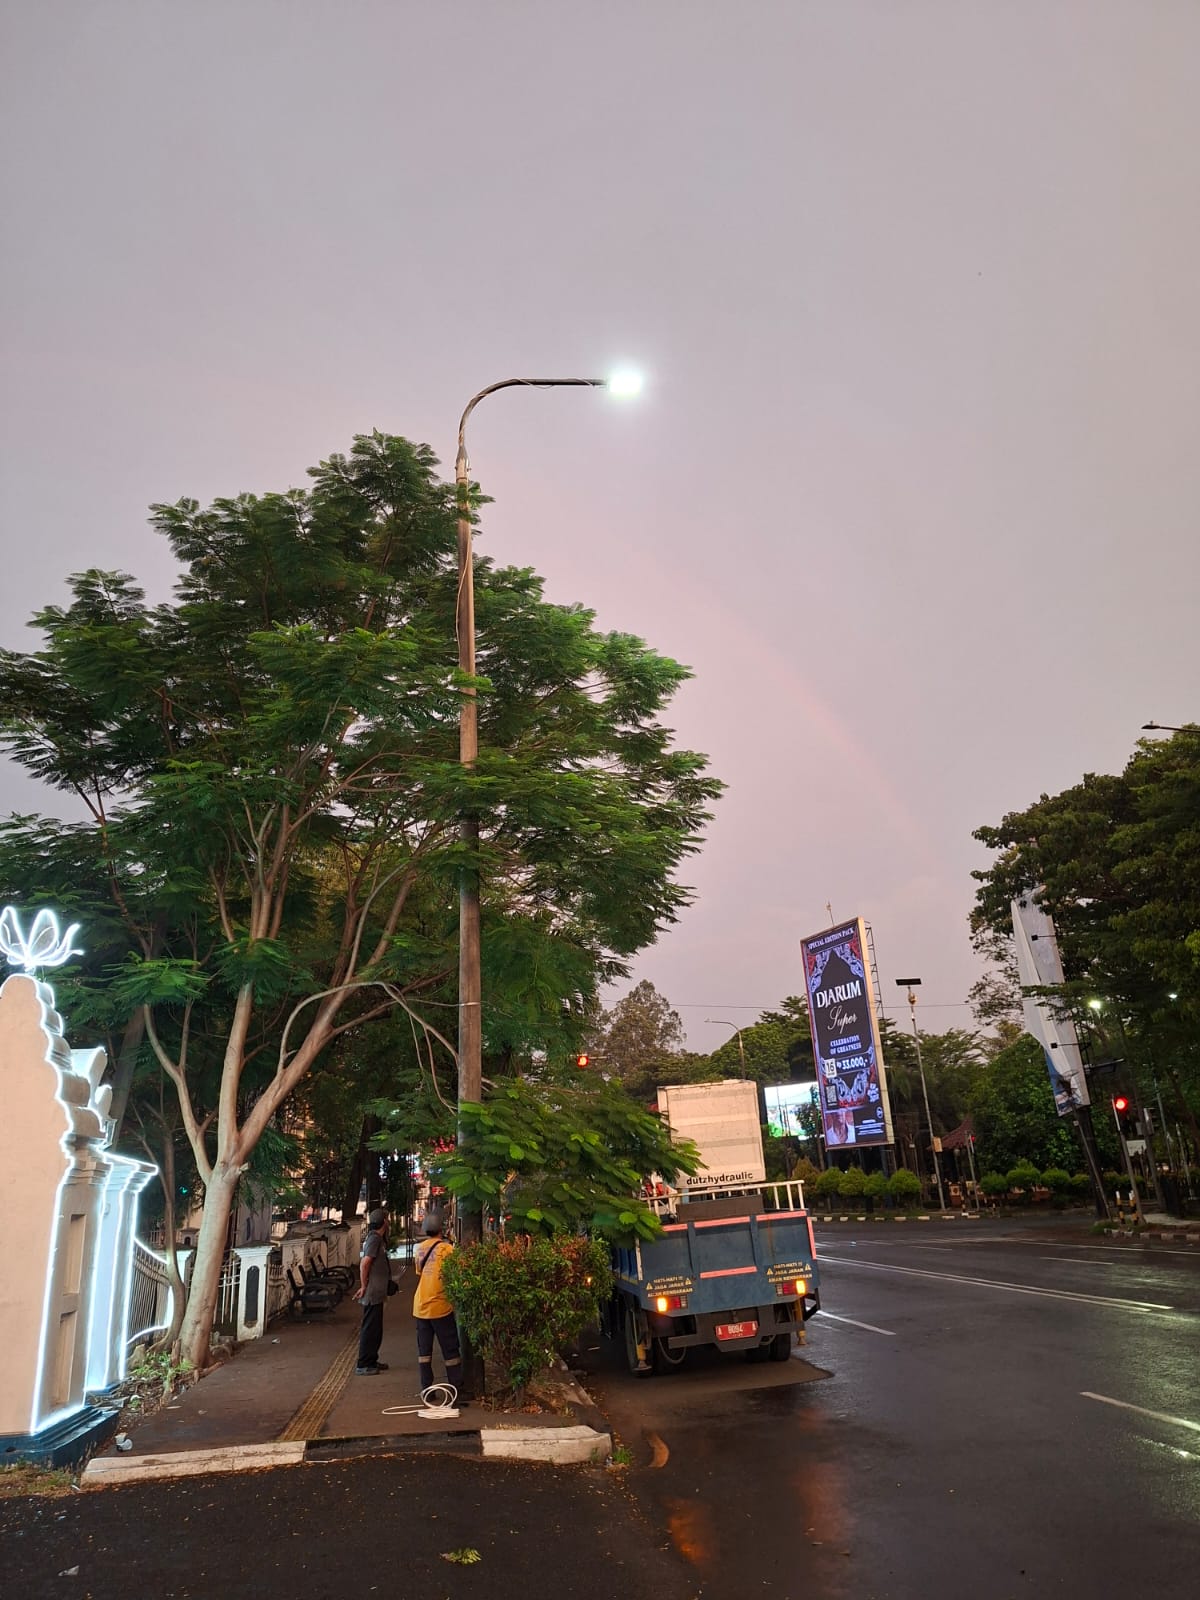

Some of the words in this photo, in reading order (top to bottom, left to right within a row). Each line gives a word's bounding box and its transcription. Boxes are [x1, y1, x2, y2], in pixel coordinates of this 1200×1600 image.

[816, 980, 861, 1008] DJARUM
[828, 1005, 857, 1034] Super
[830, 1035, 860, 1047] CELEBRATION
[826, 1061, 834, 1072] 16
[687, 1171, 753, 1185] dutzhydraulic
